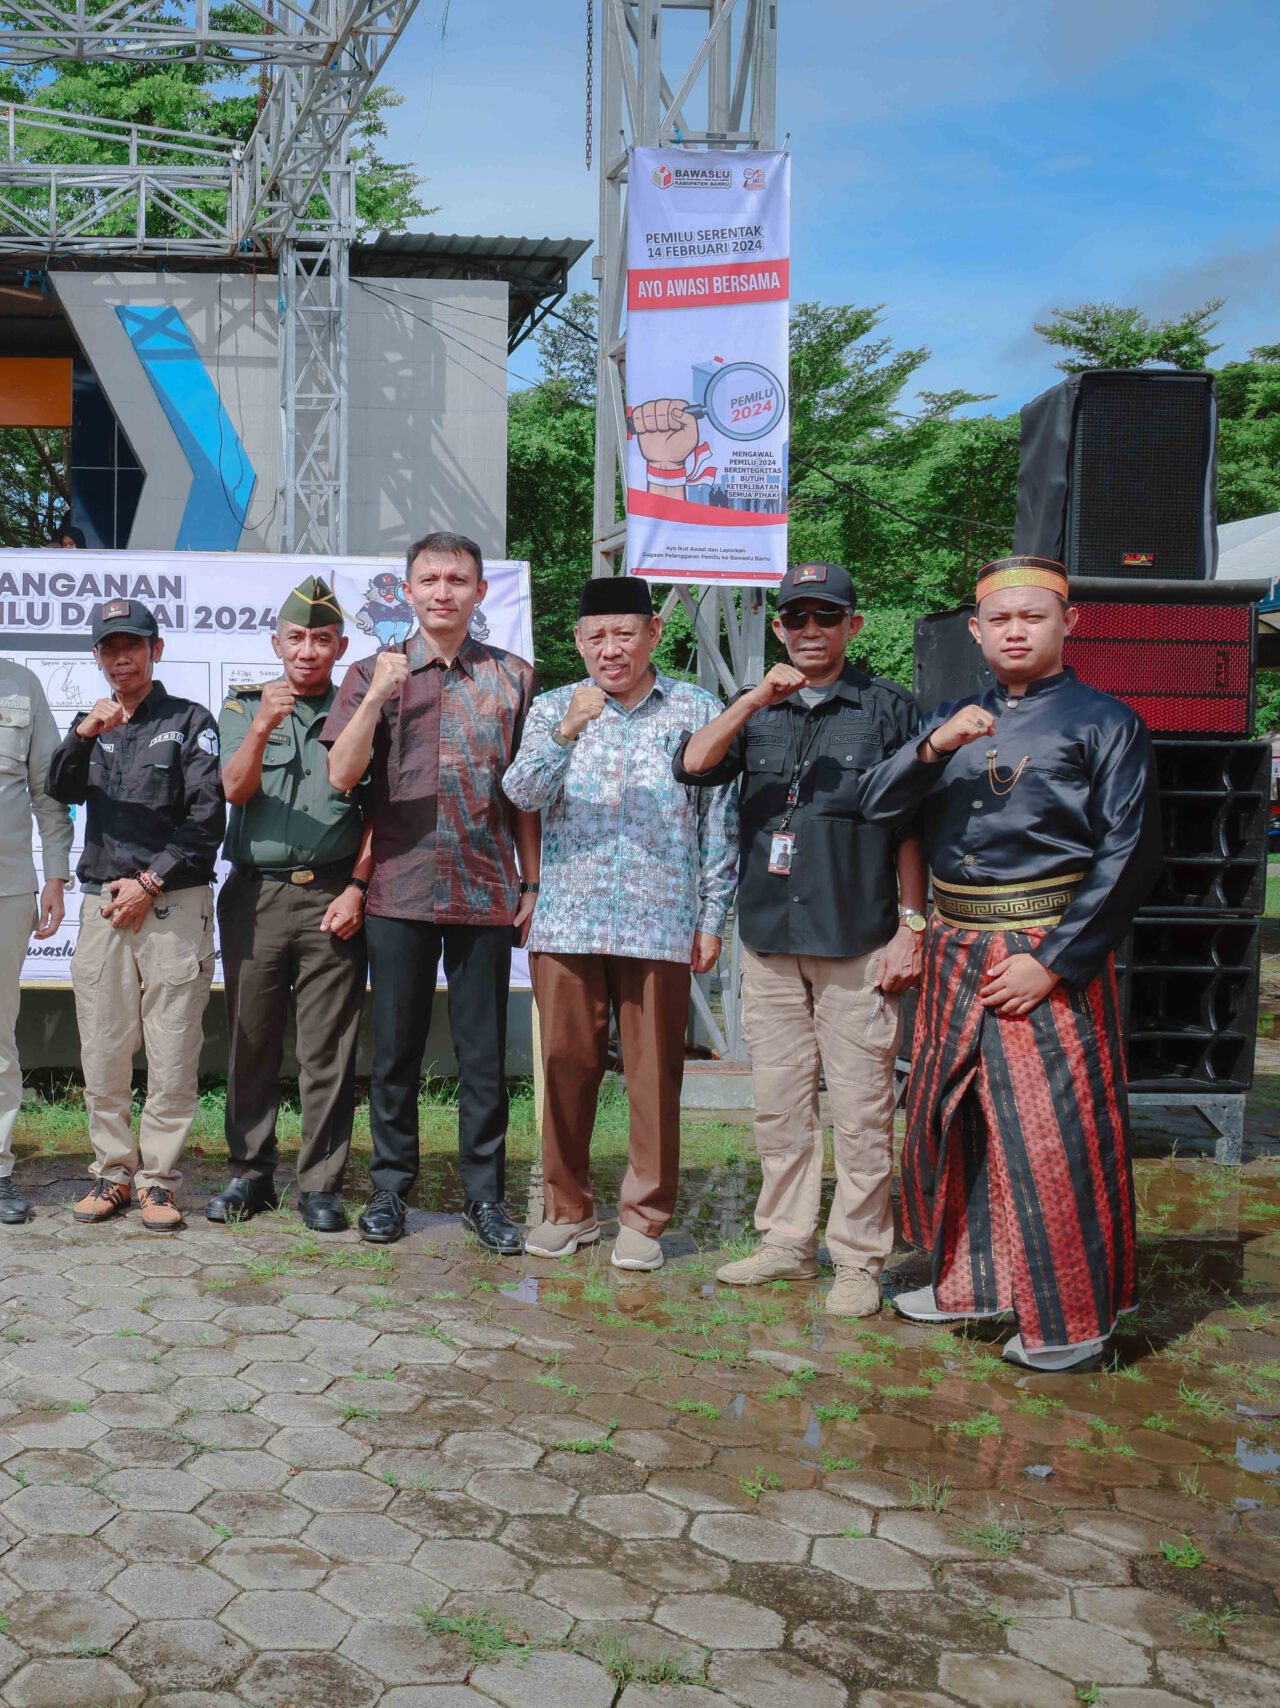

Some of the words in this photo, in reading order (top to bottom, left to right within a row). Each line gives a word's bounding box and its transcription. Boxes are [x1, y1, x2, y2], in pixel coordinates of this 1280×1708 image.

[674, 169, 730, 179] BAWASLU
[645, 230, 694, 244] PEMILU
[696, 225, 763, 241] SERENTAK
[647, 246, 662, 258] 14
[666, 243, 728, 257] FEBRUARI
[732, 239, 763, 253] 2024
[638, 280, 663, 299] AYO
[666, 277, 709, 297] AWASI
[713, 271, 781, 294] BERSAMA
[730, 387, 774, 409] PEMILU
[731, 399, 773, 423] 2024
[729, 458, 757, 466] PEMILU
[732, 450, 774, 458] MENGAWAL
[724, 466, 782, 474] BERINTEGRITAS
[194, 606, 278, 631] 2024
